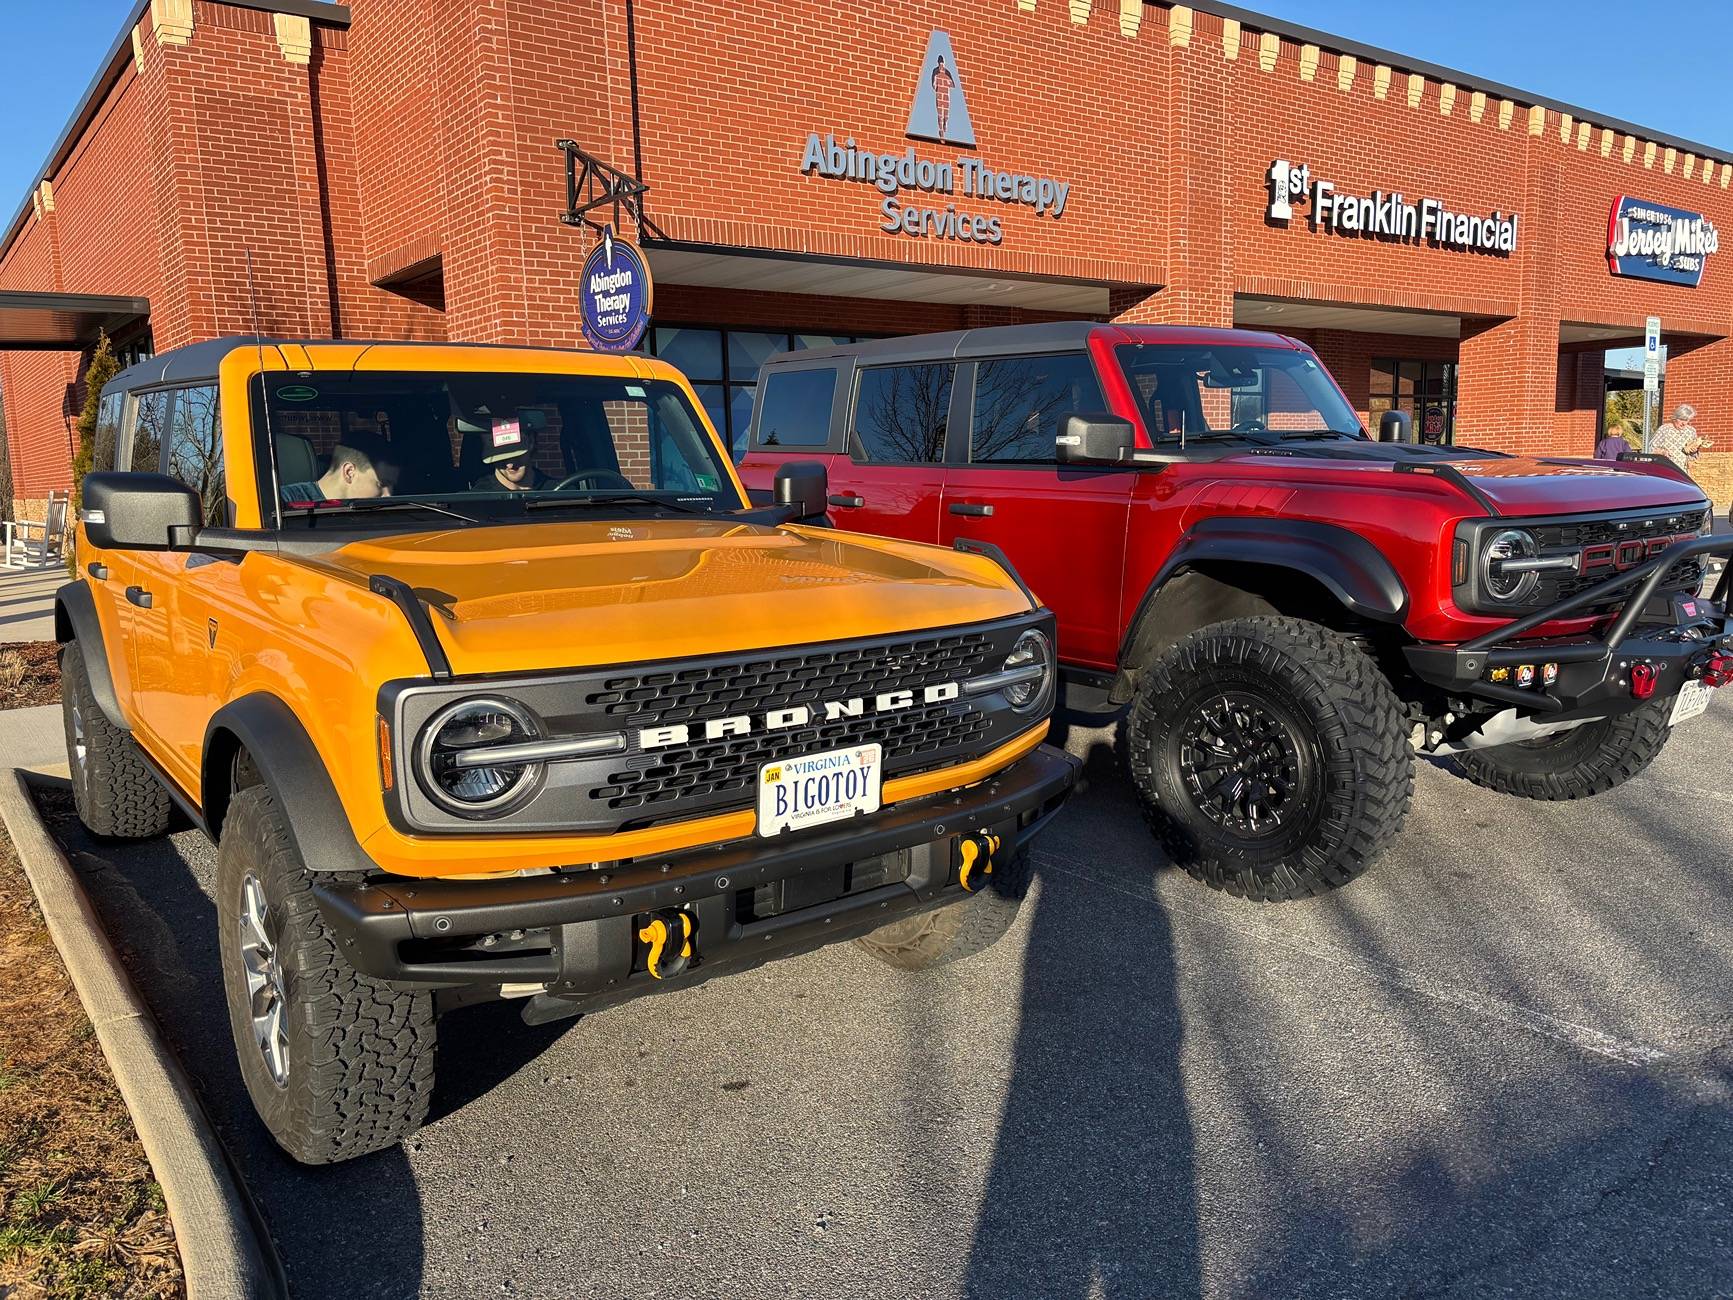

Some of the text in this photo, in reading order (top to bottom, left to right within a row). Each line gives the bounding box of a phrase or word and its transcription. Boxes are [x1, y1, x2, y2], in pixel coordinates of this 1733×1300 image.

[800, 132, 1069, 218] Abingdon Therapy
[1270, 159, 1518, 251] 1st Franklin Financial
[1632, 206, 1672, 225] SINCE 1956
[881, 196, 1002, 244] Services
[1615, 217, 1672, 266] Jersey
[1678, 255, 1700, 271] SUBS
[590, 268, 632, 293] Abingdon
[594, 292, 631, 313] Therapy
[597, 312, 627, 327] Services
[639, 682, 959, 749] BRONCO
[766, 771, 780, 783] JAN
[794, 754, 851, 775] VIRGINIA
[775, 766, 872, 817] BIGOTOY
